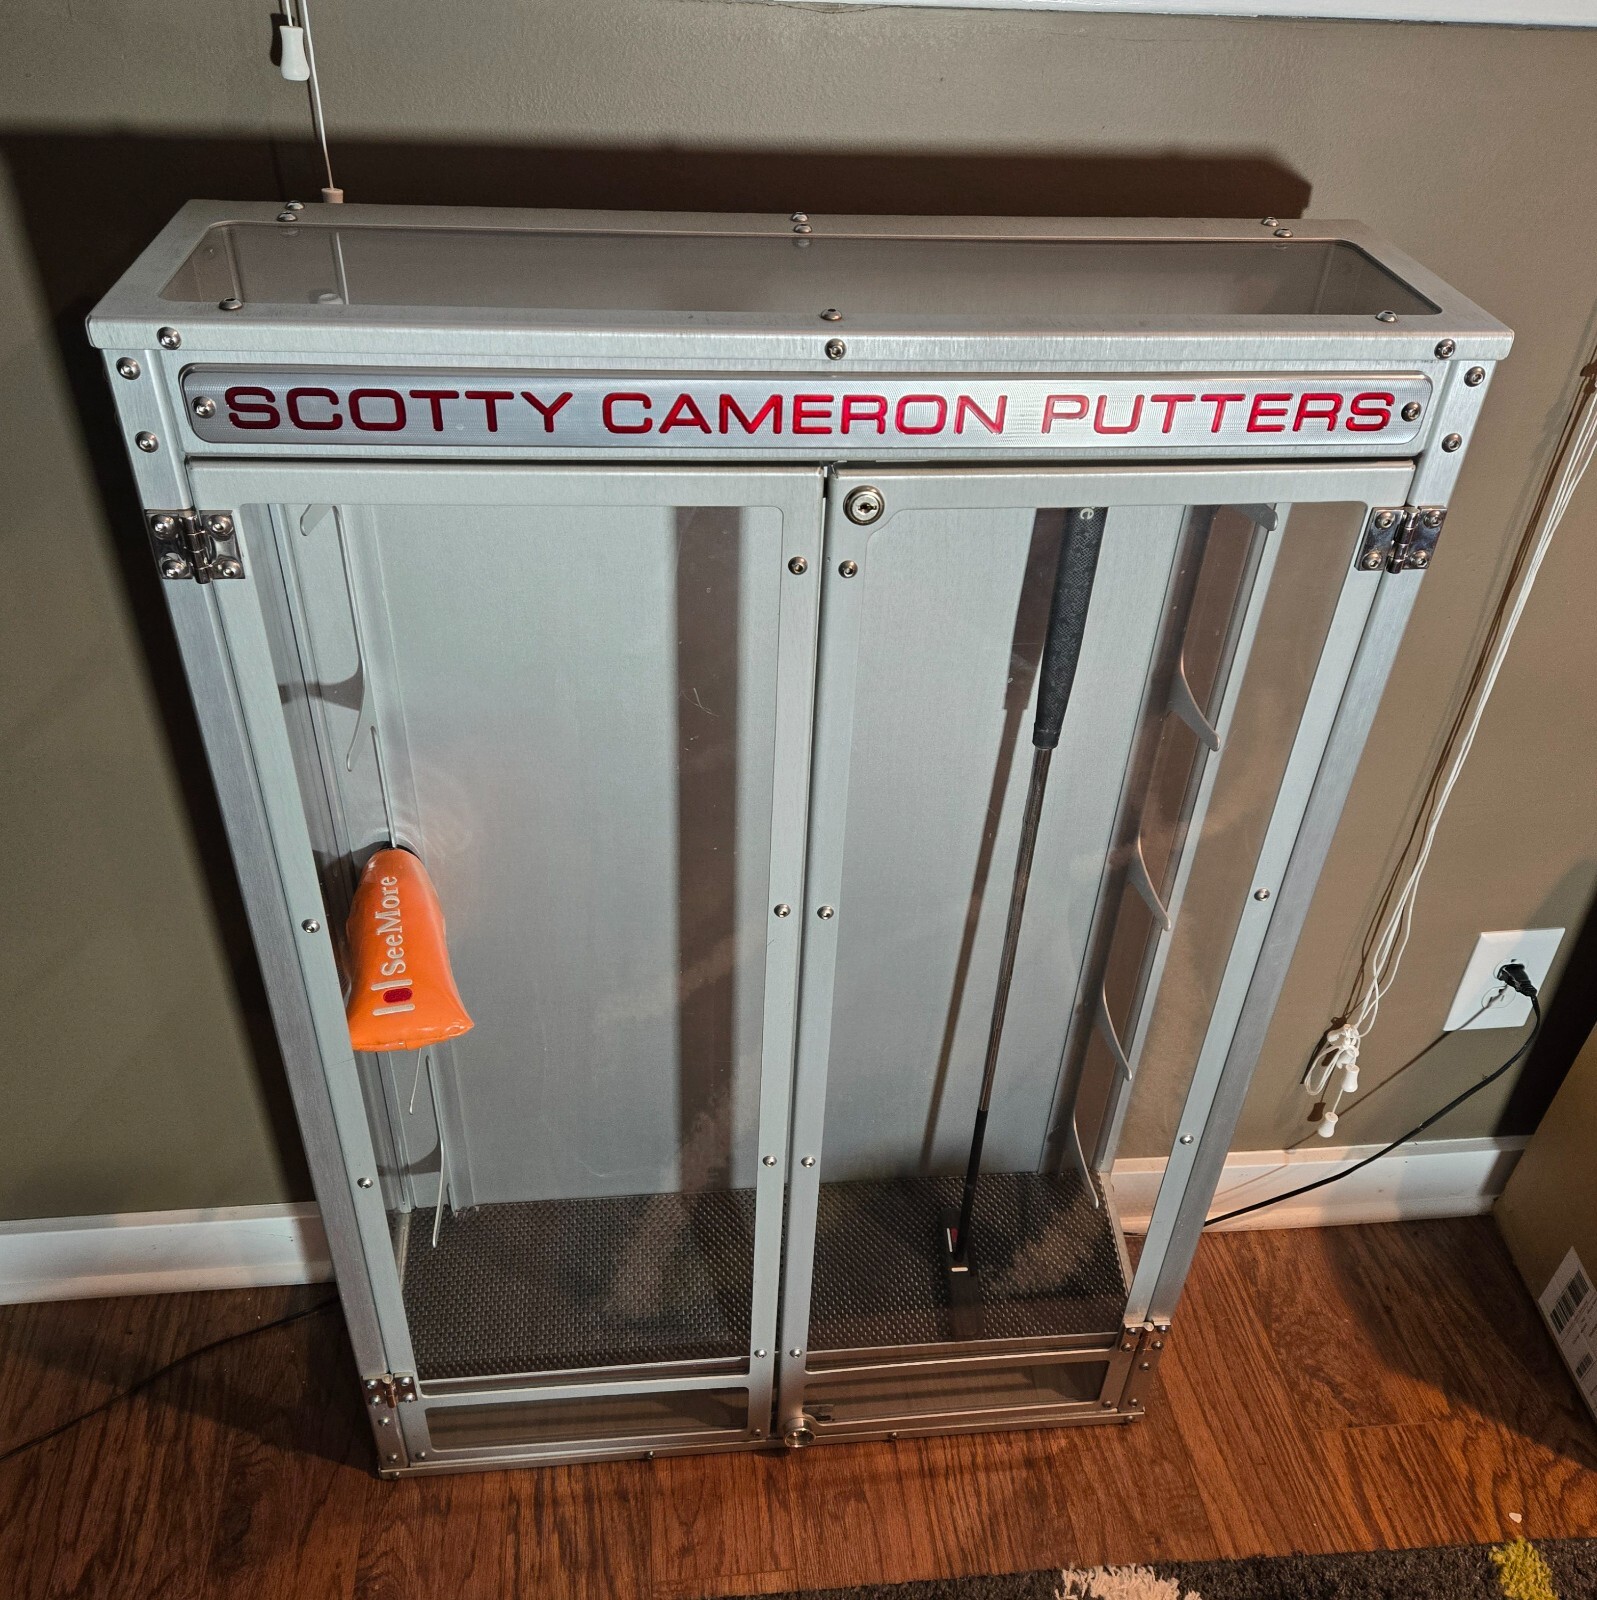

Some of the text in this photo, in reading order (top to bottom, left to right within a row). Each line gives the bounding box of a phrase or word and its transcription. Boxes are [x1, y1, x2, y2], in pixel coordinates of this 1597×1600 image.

[225, 385, 1396, 435] SCOTTY CAMERON PUTTERS
[374, 876, 406, 976] SeeMore
